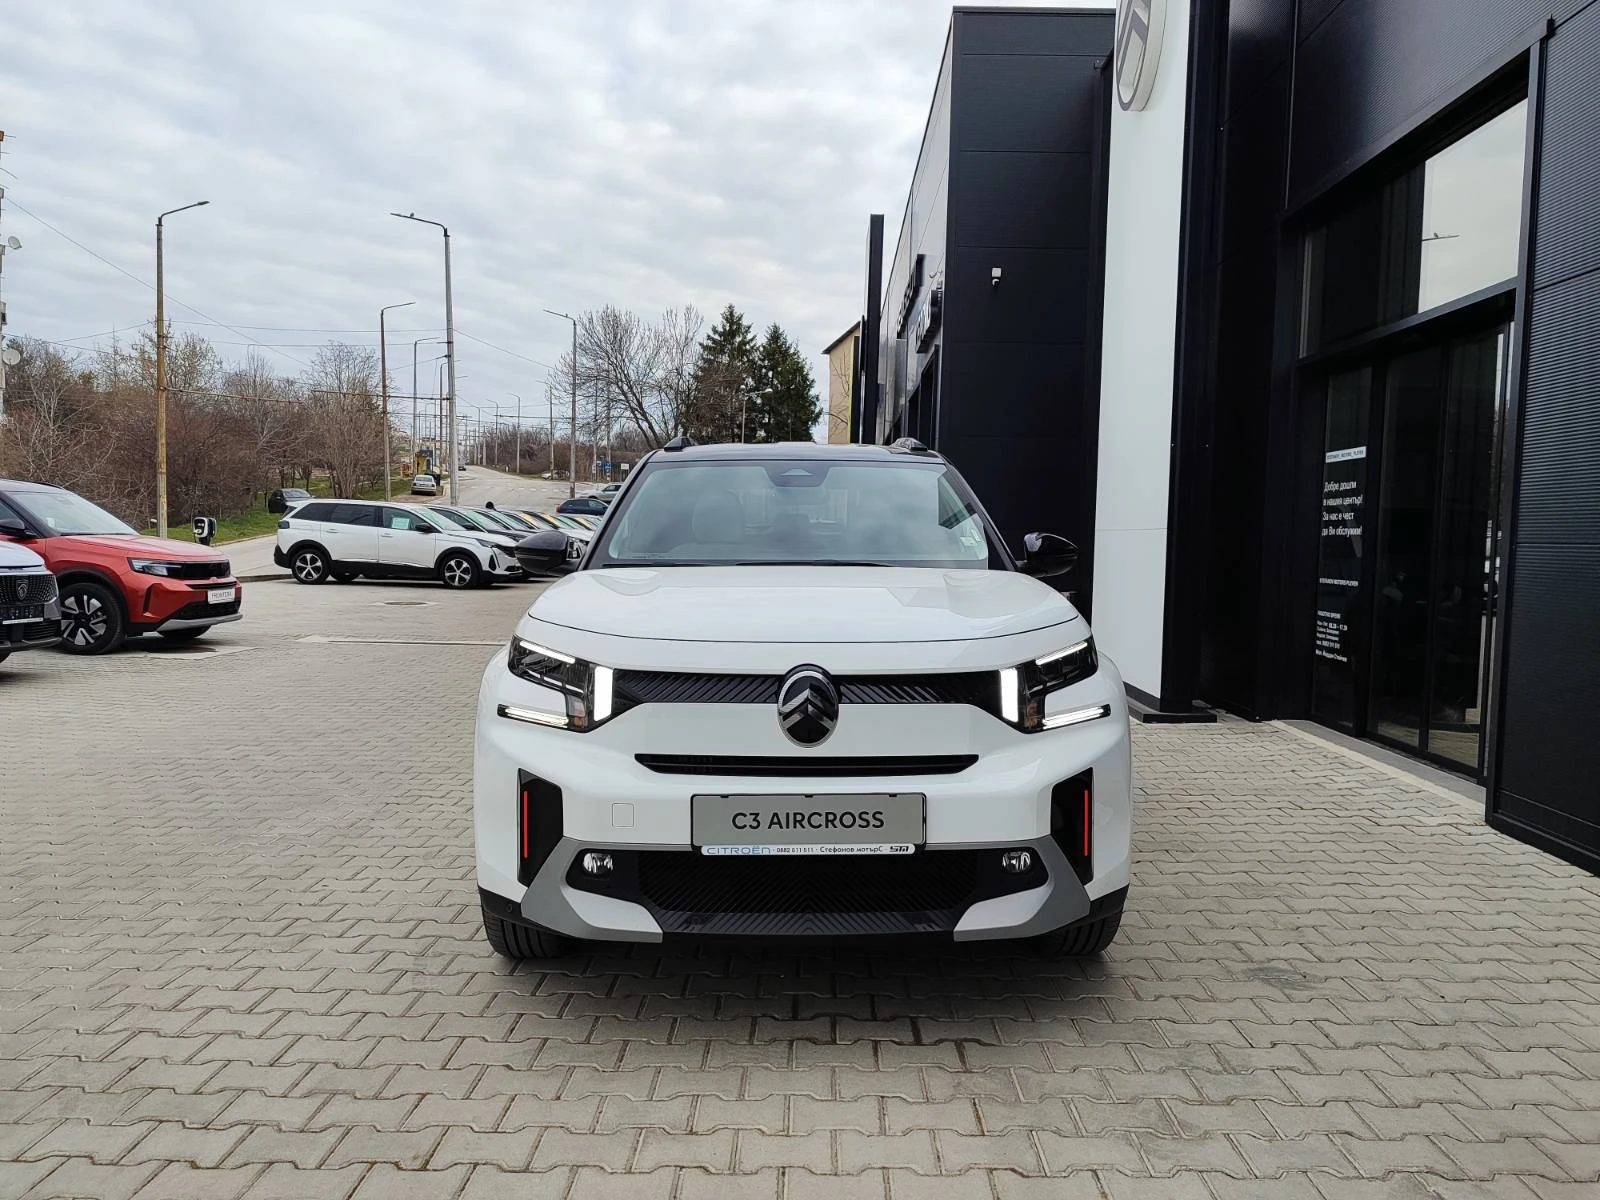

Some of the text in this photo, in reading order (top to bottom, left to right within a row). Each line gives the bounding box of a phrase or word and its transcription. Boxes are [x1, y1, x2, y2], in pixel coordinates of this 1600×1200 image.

[1322, 512, 1328, 520] За
[731, 811, 884, 829] C3 AIRCROSS
